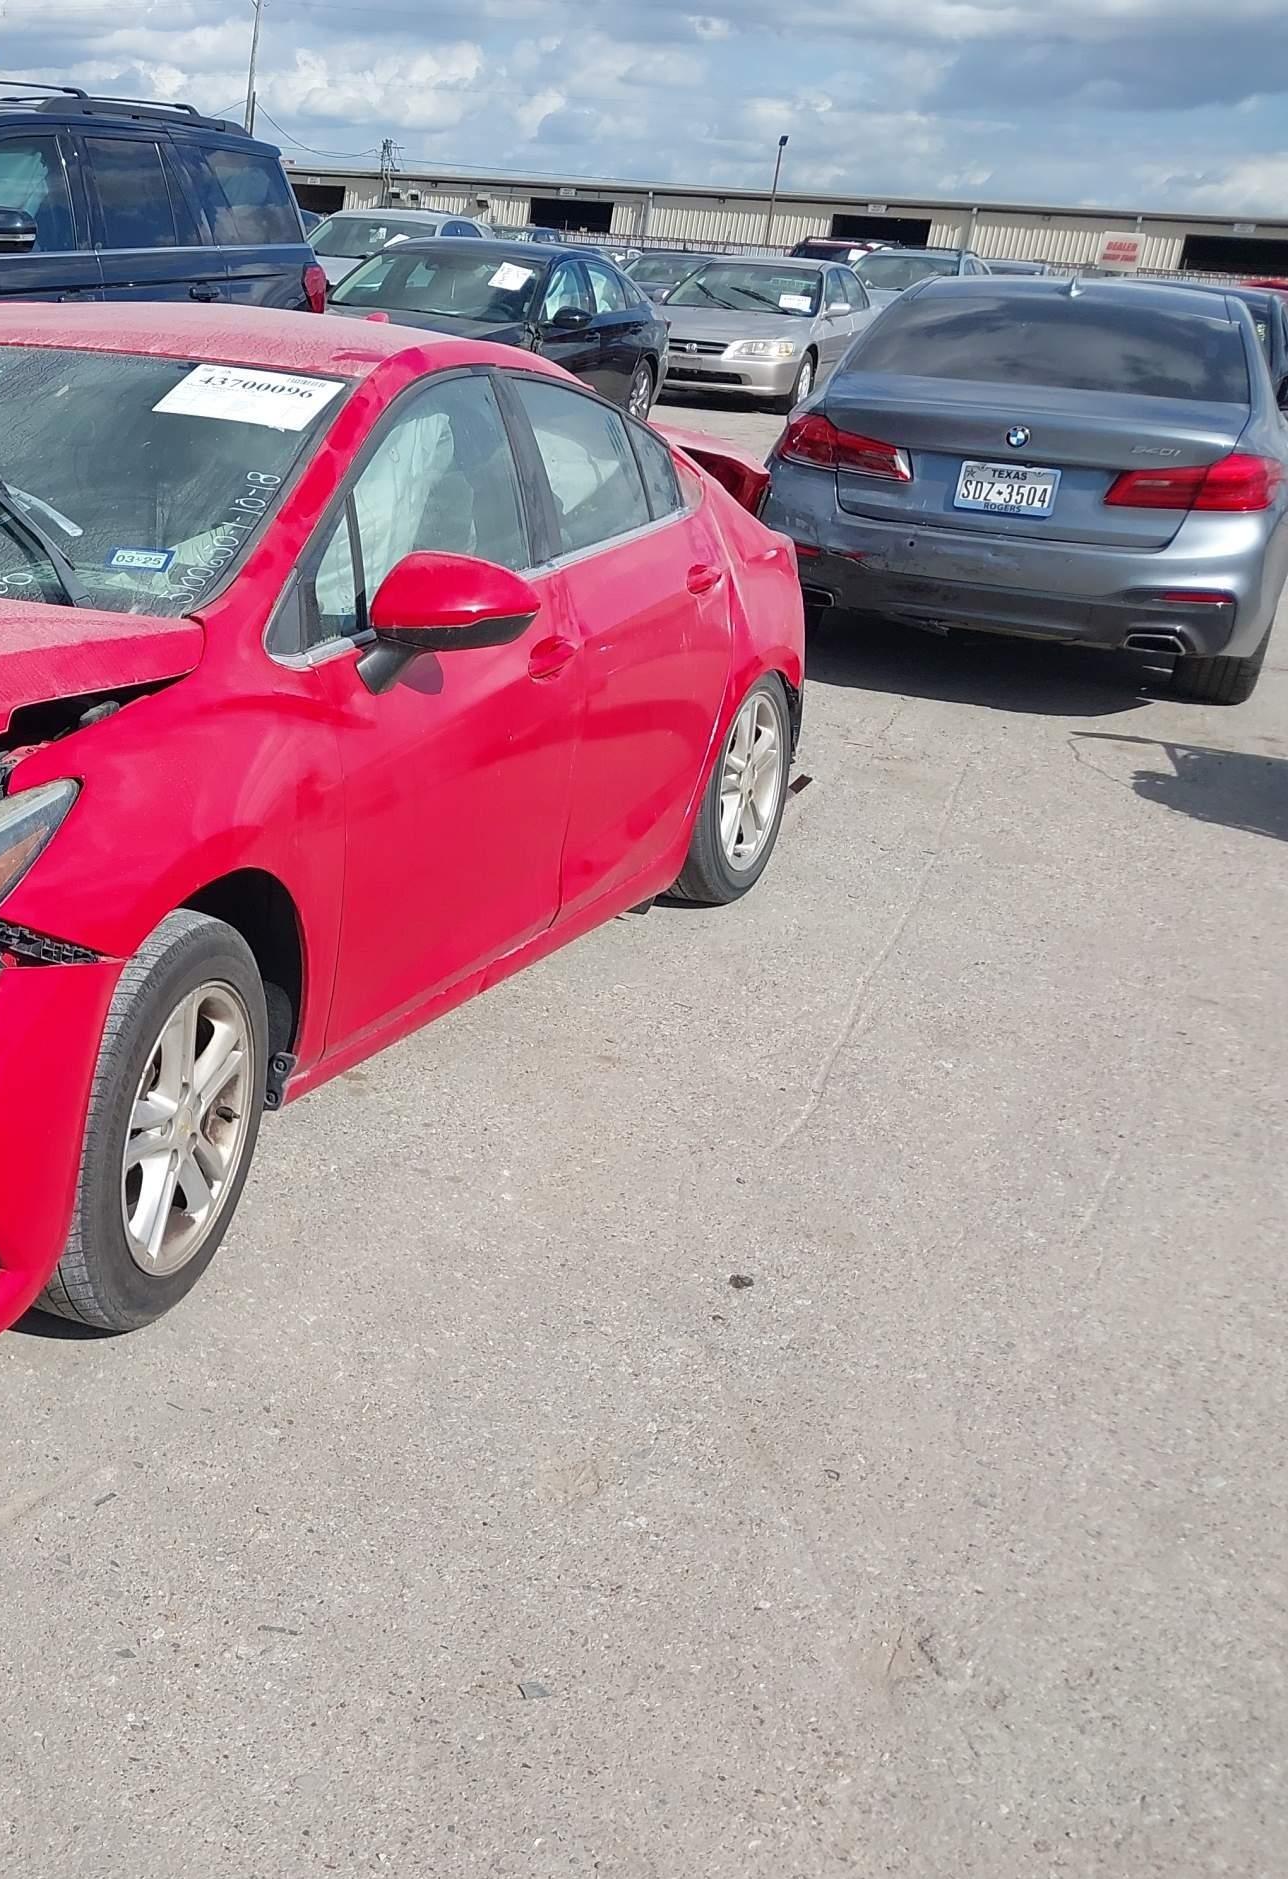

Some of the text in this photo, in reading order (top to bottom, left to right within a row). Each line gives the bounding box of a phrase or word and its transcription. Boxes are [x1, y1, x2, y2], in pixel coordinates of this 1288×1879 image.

[200, 376, 314, 399] 43700096
[992, 469, 1027, 481] TEXAS
[984, 502, 1021, 512] ROGERS
